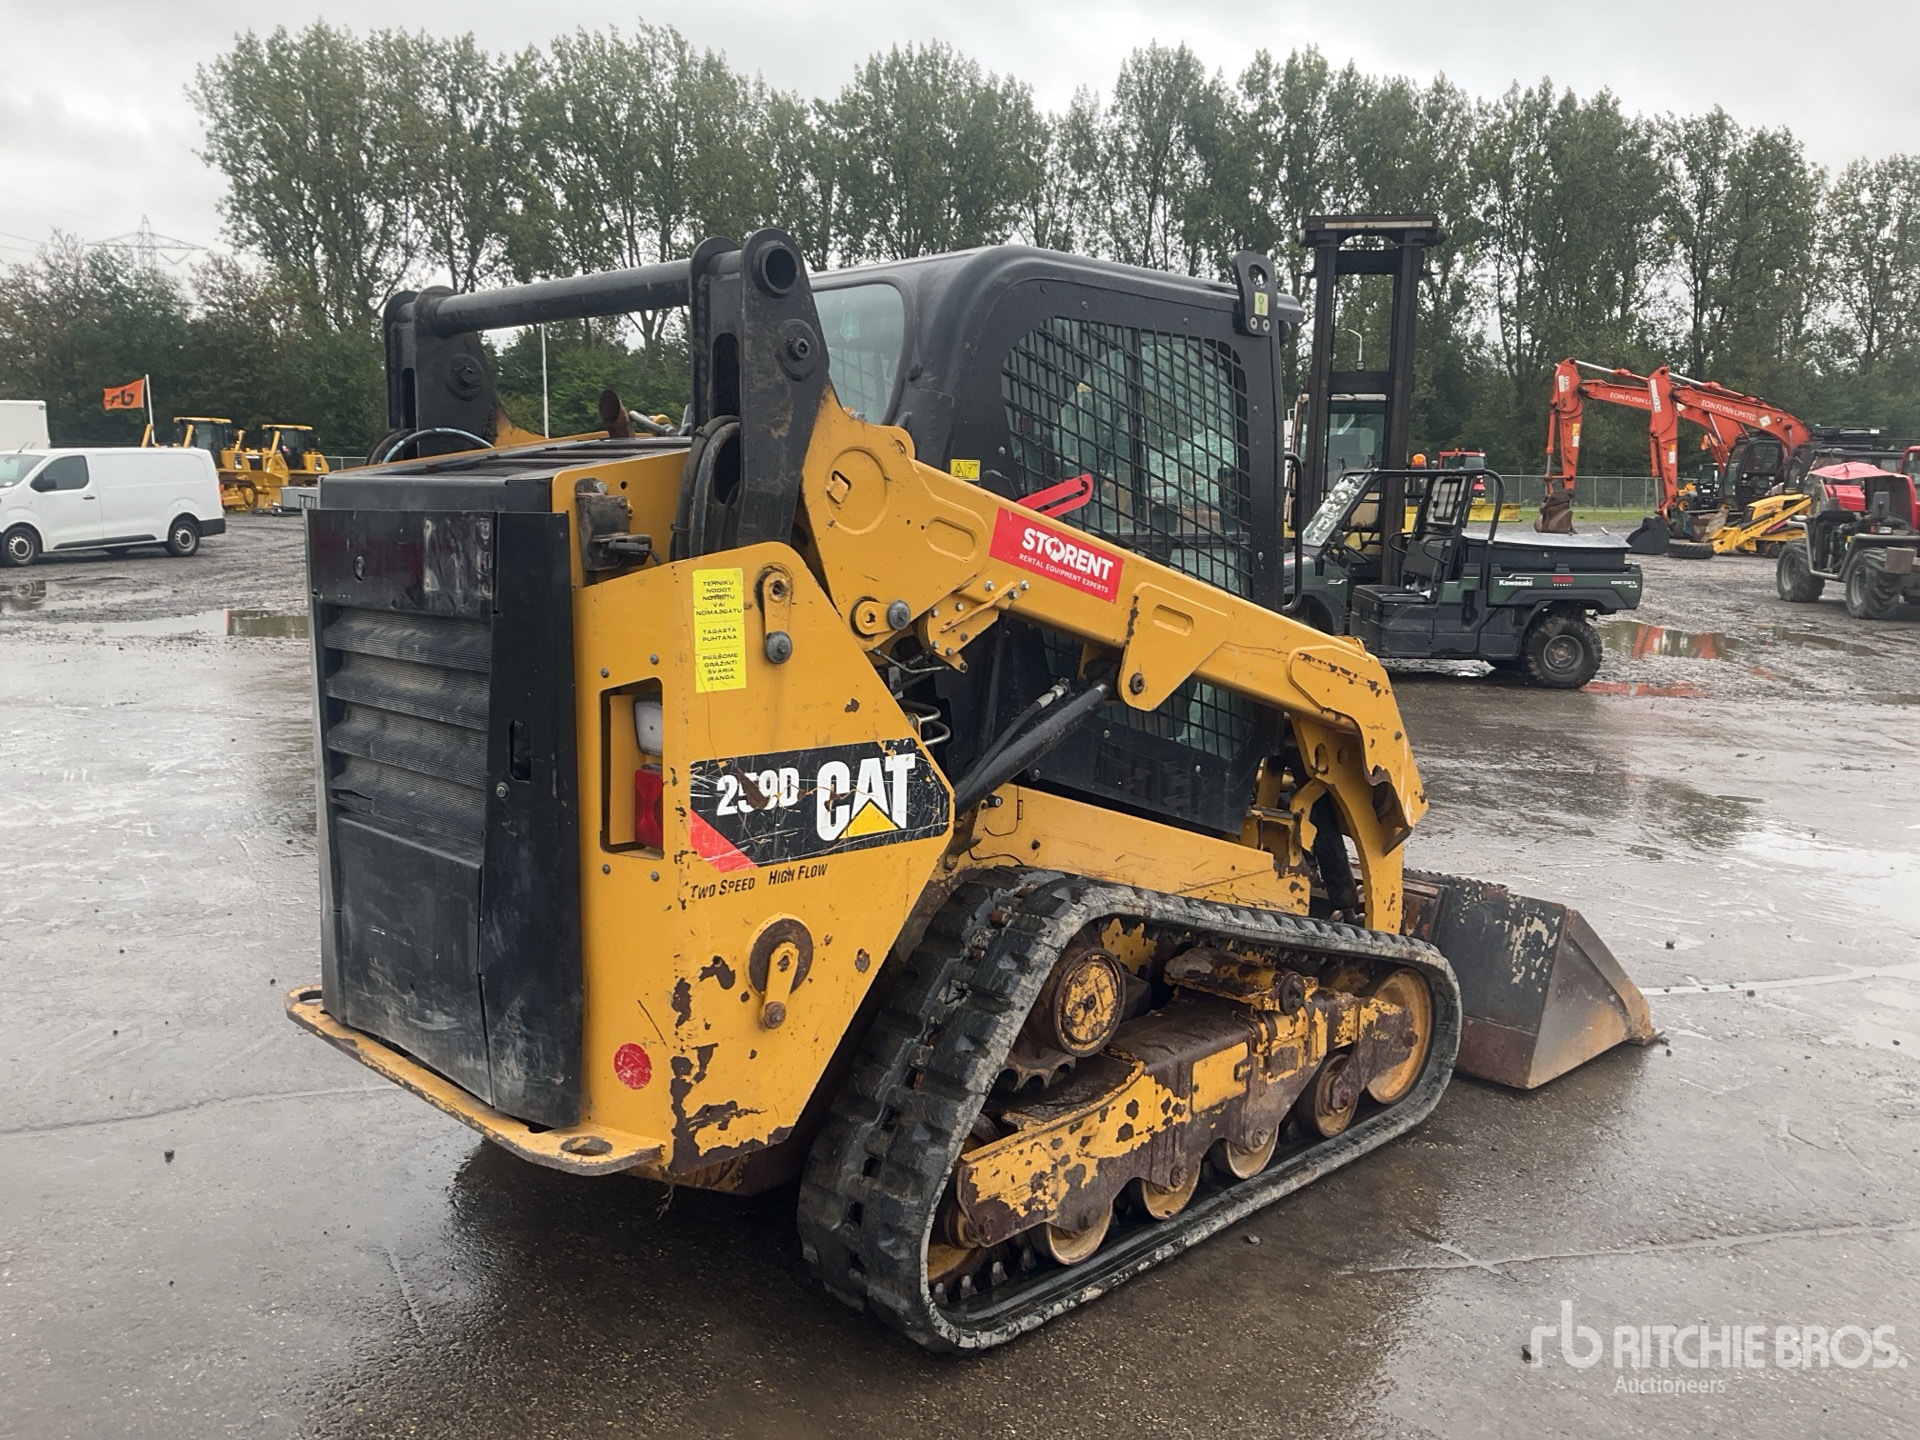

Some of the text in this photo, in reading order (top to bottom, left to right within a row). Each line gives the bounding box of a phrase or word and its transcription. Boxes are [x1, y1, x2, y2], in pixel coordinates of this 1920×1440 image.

[1609, 391, 1625, 401] EOIN
[1625, 394, 1645, 404] FLYNN
[1701, 399, 1757, 421] EOIN FLYNN LIMITED
[1021, 527, 1114, 581] STORENT
[1018, 553, 1109, 593] RENTAL EQUIPMENT EXPERTS
[702, 634, 737, 642] PUHTANA
[816, 752, 916, 841] CAT
[690, 863, 828, 899] TWO SPEED HIGH FLOW
